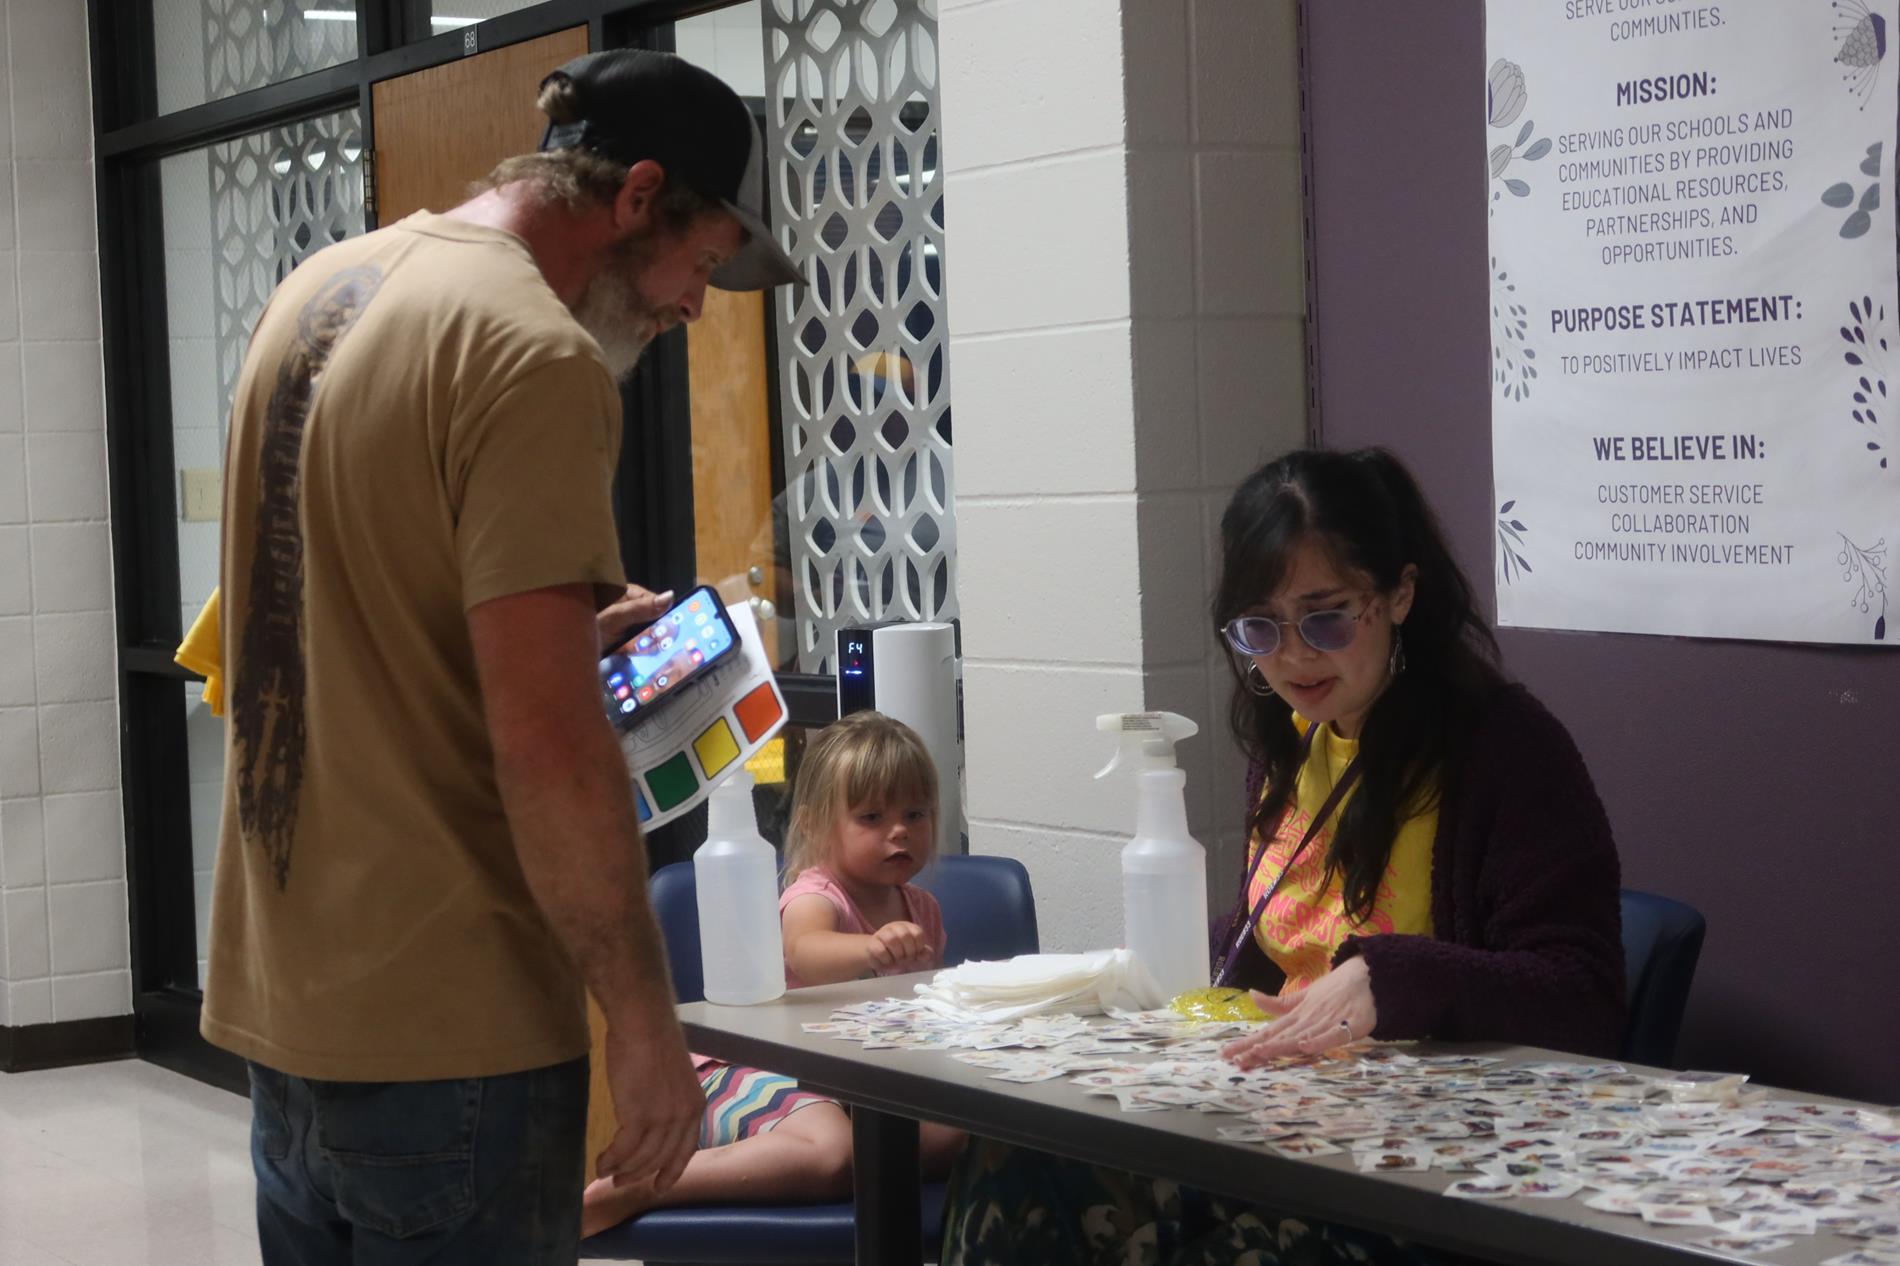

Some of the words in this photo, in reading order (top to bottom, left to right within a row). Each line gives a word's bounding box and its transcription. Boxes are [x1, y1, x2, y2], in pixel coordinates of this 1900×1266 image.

[1566, 0, 1613, 20] SERVE
[1611, 7, 1725, 41] COMMUNTIES.
[464, 31, 476, 48] 68
[1617, 71, 1716, 107] MISSION:
[1559, 128, 1623, 154] SERVING
[1629, 124, 1661, 145] OUR
[1667, 113, 1749, 141] SCHOOLS
[1754, 109, 1792, 131] AND
[1559, 154, 1664, 183] COMMUNITIES
[1670, 150, 1691, 170] BY
[1697, 139, 1793, 167] PROVIDING
[1563, 182, 1671, 211] EDUCATIONAL
[1676, 171, 1787, 198] RESOURCES,
[1587, 209, 1714, 237] PARTNERSHIPS,
[1720, 204, 1757, 225] AND
[1602, 236, 1737, 265] OPPORTUNITIES.
[1551, 305, 1645, 333] PURPOSE
[1651, 295, 1802, 328] STATEMENT:
[1561, 356, 1578, 374] TO
[1584, 352, 1673, 373] POSITIVELY
[1679, 348, 1743, 370] IMPACT
[1749, 345, 1801, 367] LIVES
[1593, 437, 1626, 461] WE
[1632, 435, 1726, 461] BELIEVE
[1733, 434, 1765, 460] IN:
[1598, 485, 1684, 504] CUSTOMER
[1690, 485, 1763, 504] SERVICE
[1612, 513, 1749, 534] COLLABORATION
[1575, 541, 1666, 562] COMMUNITY
[1672, 544, 1794, 564] INVOLVEMENT
[848, 642, 863, 654] F4
